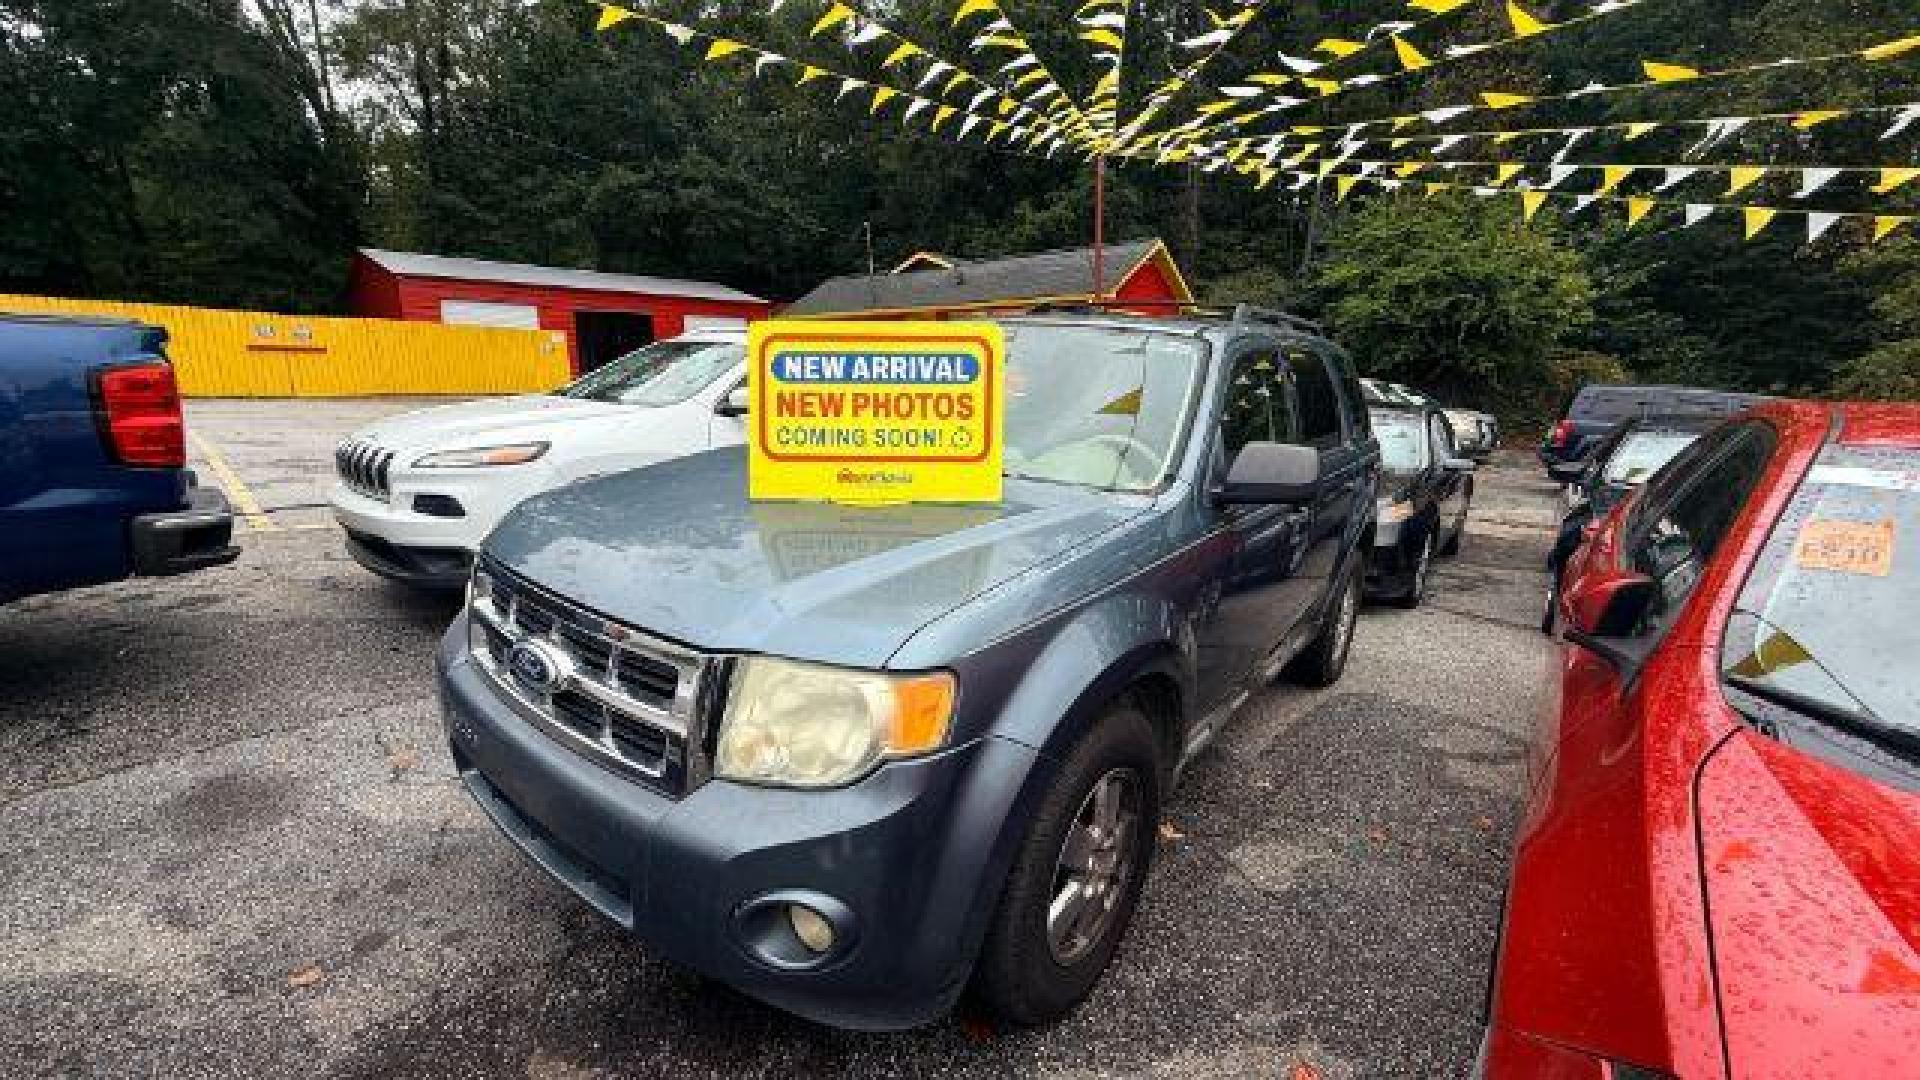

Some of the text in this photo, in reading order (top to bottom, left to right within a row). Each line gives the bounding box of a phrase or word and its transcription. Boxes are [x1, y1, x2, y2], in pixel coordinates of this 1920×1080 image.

[785, 356, 970, 381] NEW ARRIVAL
[776, 392, 975, 420] NEW PHOTOS
[776, 426, 943, 448] COMING SOON!
